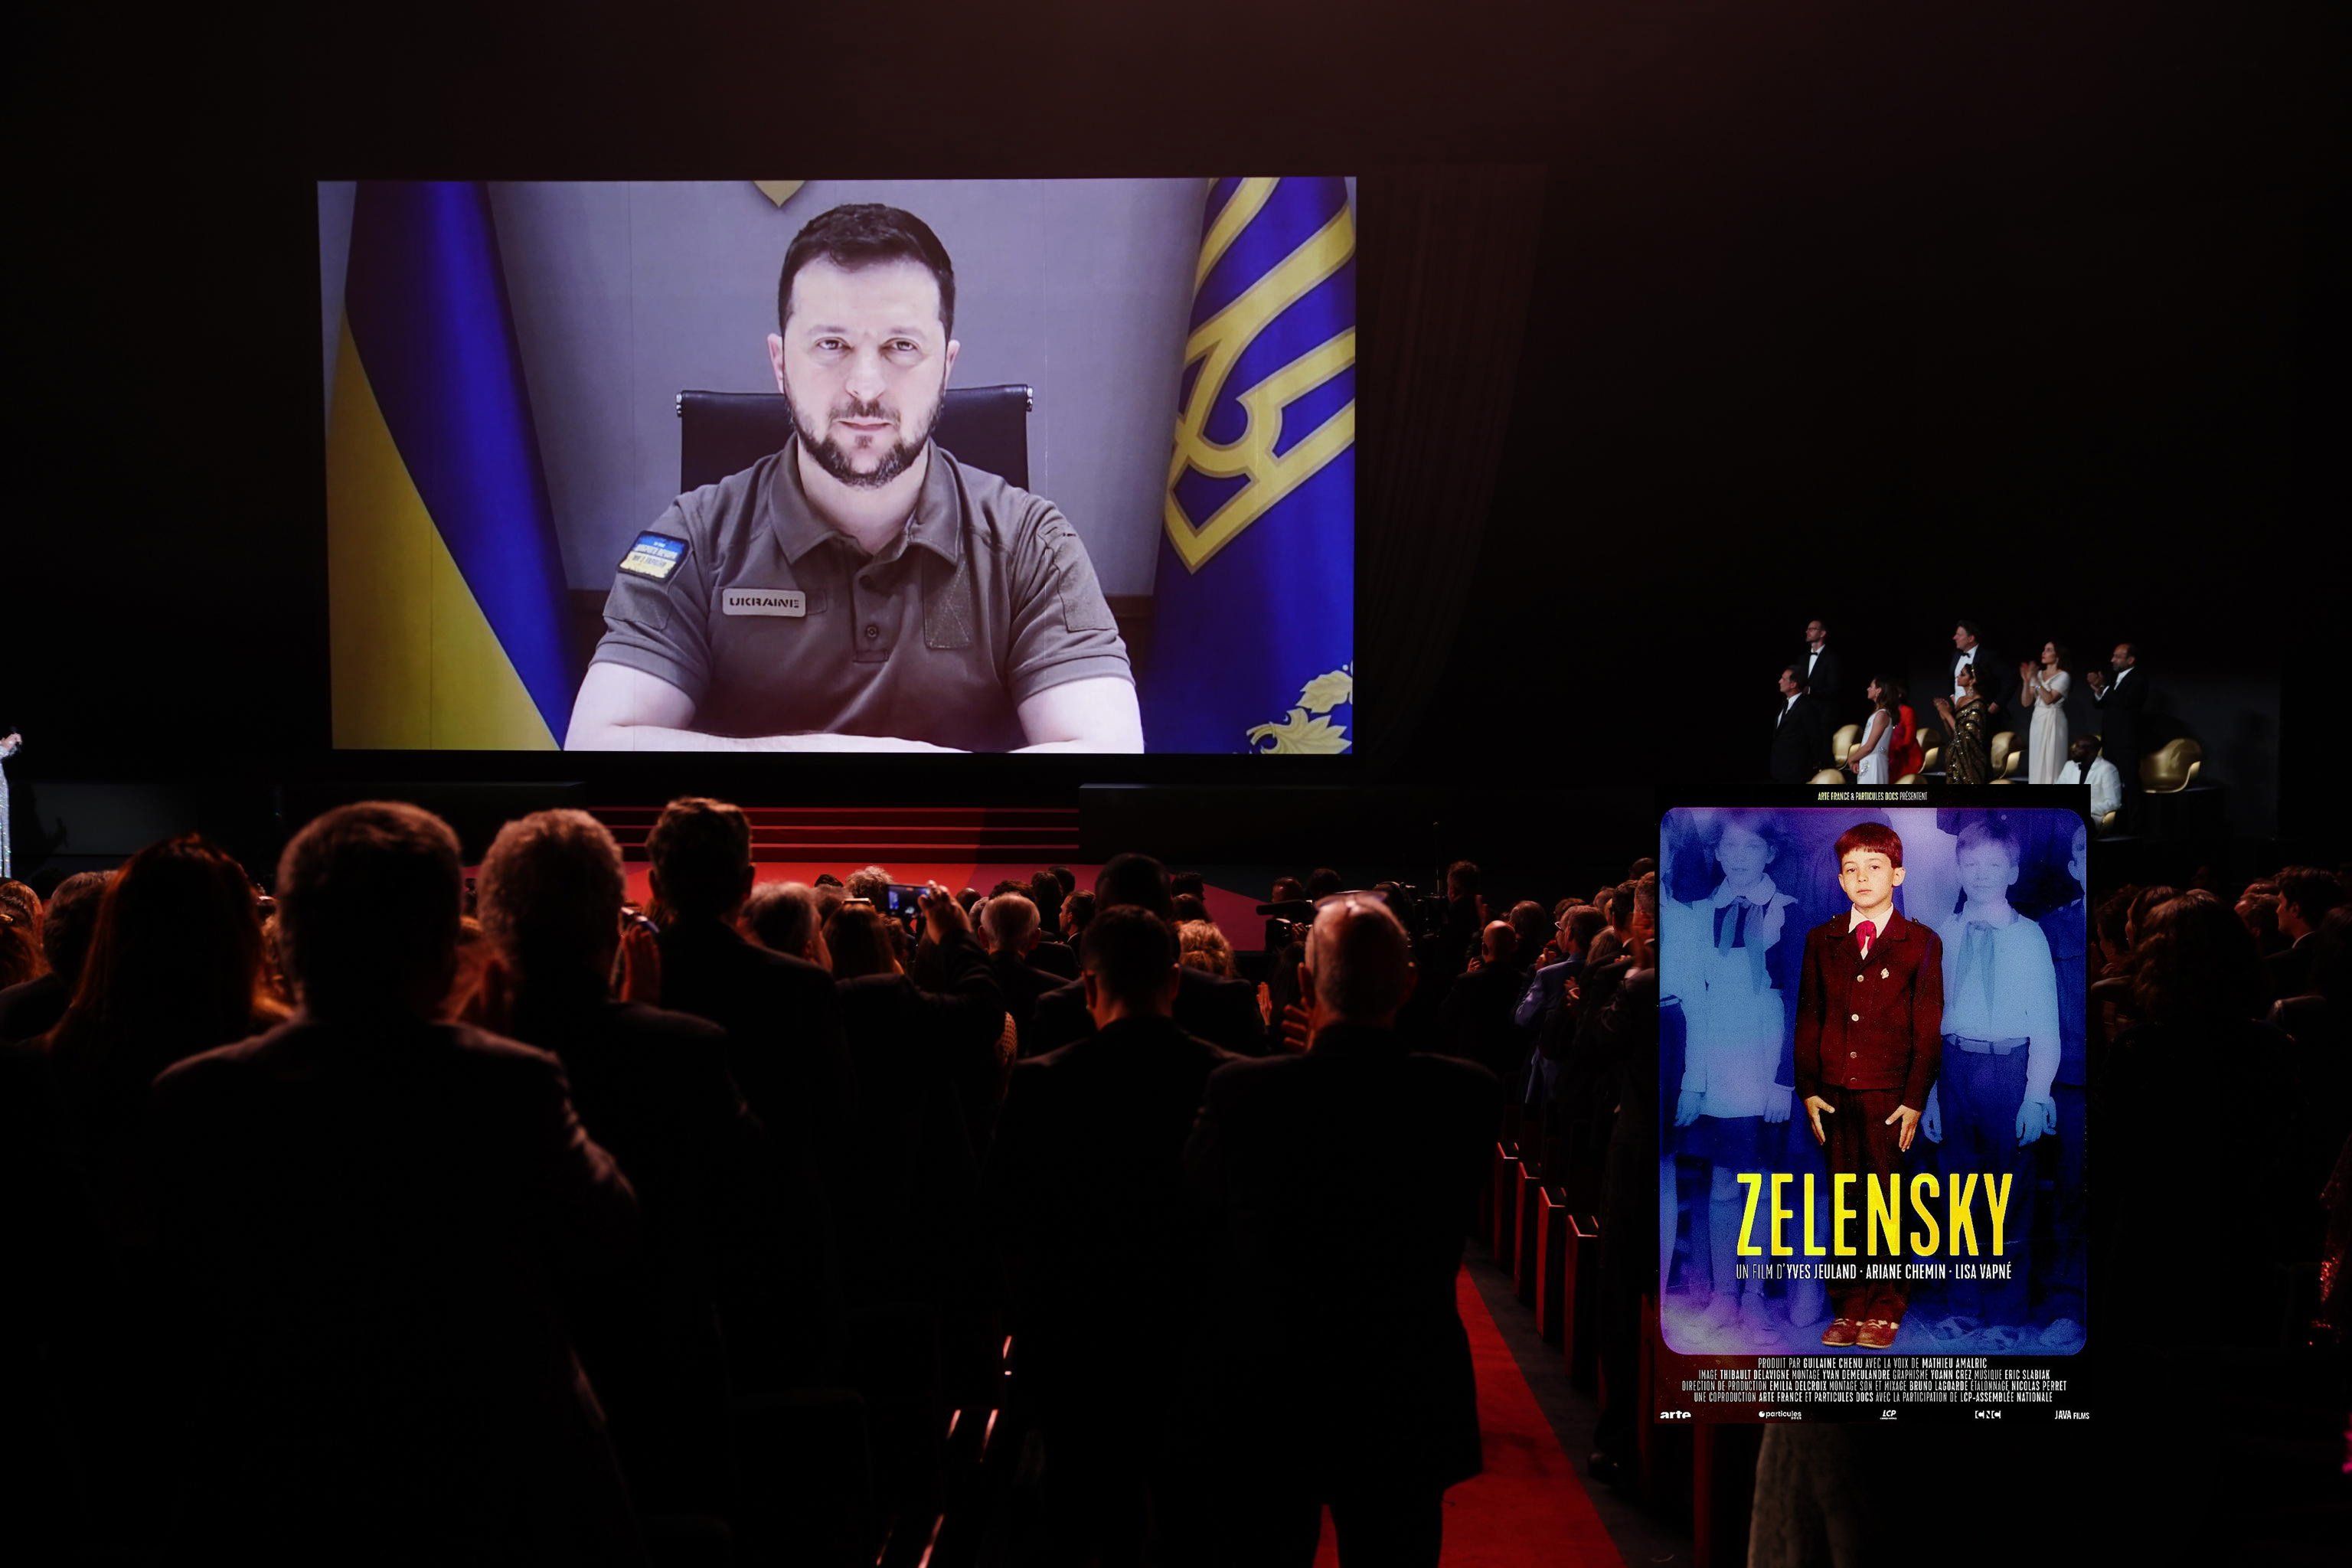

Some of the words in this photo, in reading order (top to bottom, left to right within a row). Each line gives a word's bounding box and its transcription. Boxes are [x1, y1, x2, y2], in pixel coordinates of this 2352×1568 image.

[730, 597, 800, 609] UKRAINE
[1900, 791, 1927, 800] PRÉSENTENT
[1737, 1174, 2012, 1256] ZELENSKY
[1736, 1264, 1748, 1279] UN
[1753, 1264, 1772, 1279] FILM
[1777, 1263, 1810, 1279] D'YVES
[1815, 1264, 1856, 1279] JEULAND
[1866, 1264, 1901, 1279] ARIANE
[1906, 1264, 1945, 1279] CHEMIN
[1956, 1264, 1976, 1279] LISA
[1980, 1262, 2011, 1279] VAPNÉ
[1759, 1357, 1785, 1368] PRODUIT
[1789, 1358, 1800, 1368] PAR
[1804, 1358, 1835, 1368] GUILAINE
[1839, 1358, 1862, 1368] CHENU
[1866, 1357, 1880, 1368] AVEC
[1884, 1358, 1890, 1368] LA
[1894, 1358, 1908, 1368] VOIX
[1912, 1358, 1919, 1368] DE
[1922, 1358, 1952, 1368] MATHIEU
[1956, 1358, 1987, 1368] AMALRIC
[1699, 1370, 1717, 1380] IMAGE
[1720, 1370, 1751, 1380] THIBAULT
[1754, 1370, 1789, 1380] DELAVIGNE
[1792, 1370, 1819, 1380] MONTAGE
[1823, 1370, 1839, 1379] YVAN
[1842, 1370, 1890, 1380] DEMEULANDRE
[1893, 1370, 1928, 1380] GRAPHISME
[1931, 1370, 1952, 1379] YOANN
[1956, 1370, 1972, 1380] CREZ
[1975, 1370, 2001, 1380] MUSIQUE
[2005, 1370, 2020, 1379] ERIC
[2023, 1370, 2050, 1379] SLABIAK
[1682, 1380, 1714, 1390] DIRECTION
[1718, 1381, 1725, 1390] DE
[1728, 1380, 1766, 1390] PRODUCTION
[1770, 1381, 1792, 1390] EMILIA
[1795, 1381, 1826, 1390] DELCROIX
[1830, 1380, 1857, 1390] MONTAGE
[1860, 1381, 1872, 1390] SON
[1876, 1380, 1881, 1390] ET
[1885, 1381, 1906, 1390] MIXAGE
[1910, 1381, 1932, 1390] BRUNO
[1936, 1381, 1968, 1390] LAGOARDE
[1971, 1380, 2009, 1391] ÉTALONNAGE
[2012, 1381, 2040, 1390] NICOLAS
[2043, 1381, 2066, 1390] PERRET
[1694, 1392, 1706, 1402] UNE
[1709, 1392, 1756, 1402] COPRODUCTION
[1759, 1392, 1774, 1402] ARTE
[1778, 1392, 1802, 1402] FRANCE
[1805, 1392, 1811, 1402] ET
[1815, 1392, 1853, 1402] PARTICULES
[1857, 1392, 1873, 1402] DOCS
[1876, 1392, 1890, 1402] AVEC
[1893, 1393, 1900, 1402] LA
[1903, 1392, 1946, 1402] PARTICIPATION
[1950, 1392, 1957, 1402] DE
[1961, 1390, 2014, 1402] LCP-ASSEMBLÉE
[2017, 1392, 2052, 1402] NATIONALE
[1660, 1410, 1691, 1419] arte
[1766, 1410, 1802, 1419] particules
[2055, 1410, 2071, 1419] JAVA
